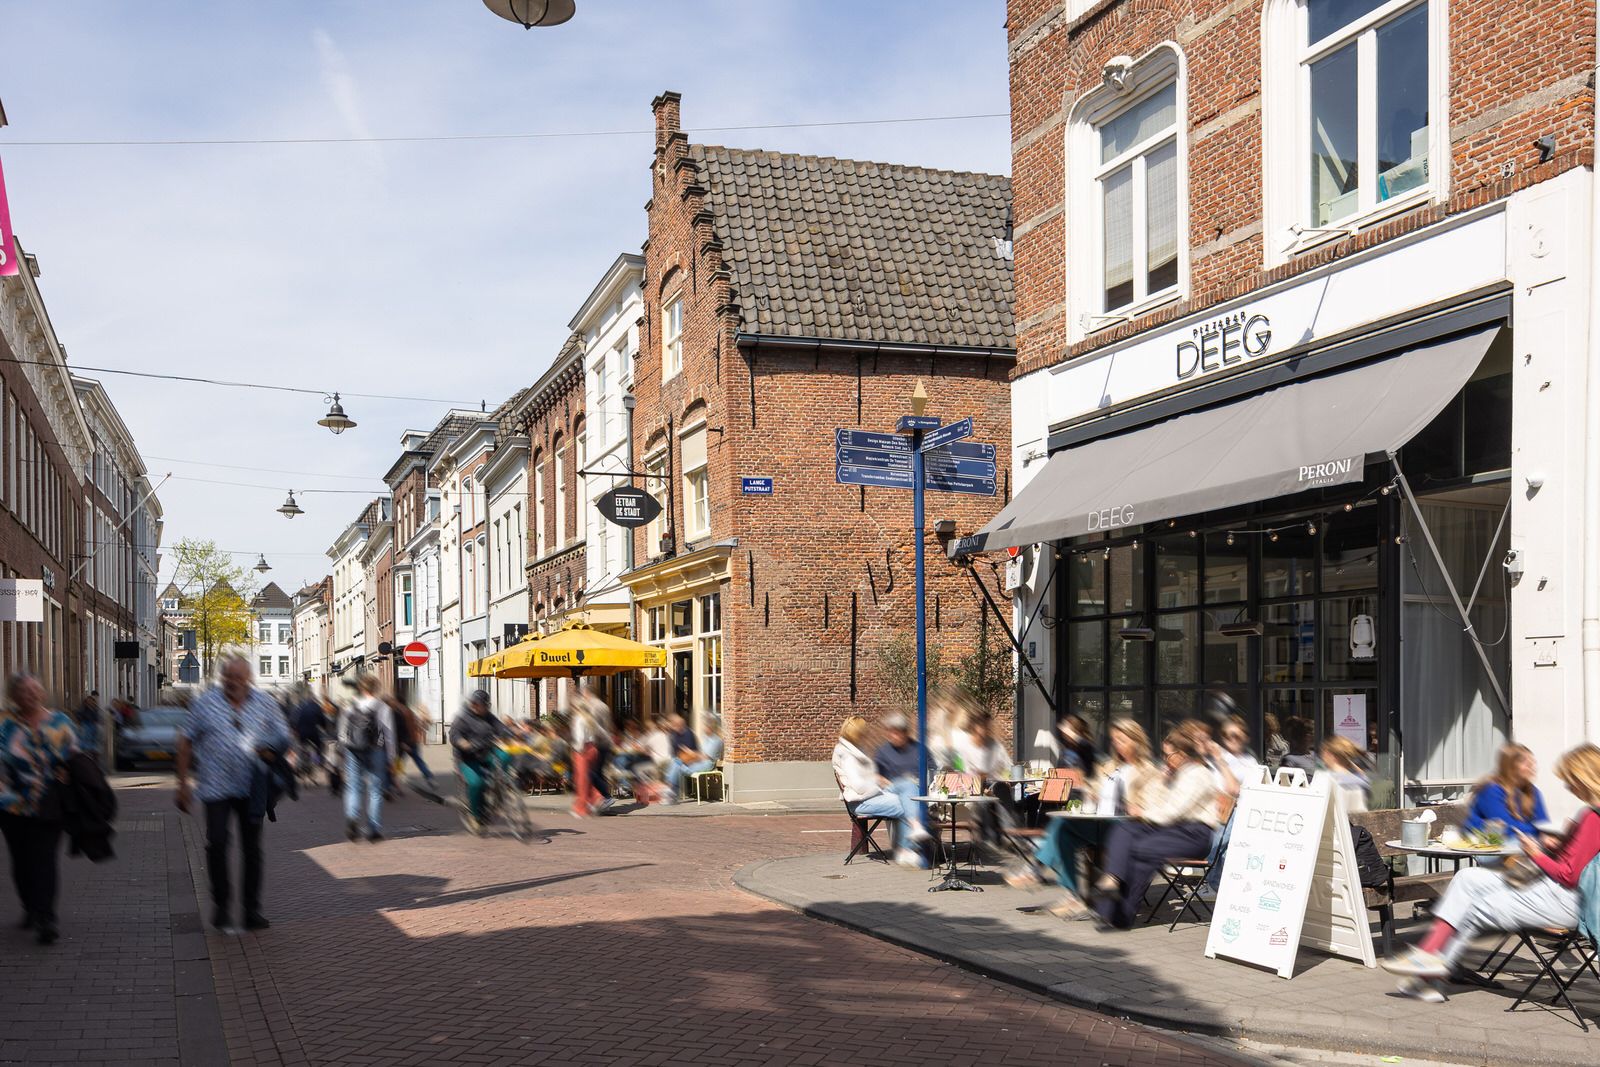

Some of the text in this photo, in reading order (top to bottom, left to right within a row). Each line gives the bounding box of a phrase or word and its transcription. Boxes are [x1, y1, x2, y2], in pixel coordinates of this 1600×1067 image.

[1192, 311, 1246, 337] PIZZABAR
[1176, 314, 1272, 378] DEEG
[1298, 459, 1352, 481] PERONI
[1311, 477, 1335, 485] ITALIA
[615, 498, 636, 507] EETBAR
[616, 507, 623, 516] DE
[1088, 504, 1134, 531] DEEG
[953, 537, 979, 549] PERONI
[540, 651, 570, 662] Duvel
[1248, 808, 1304, 836] DEEG
